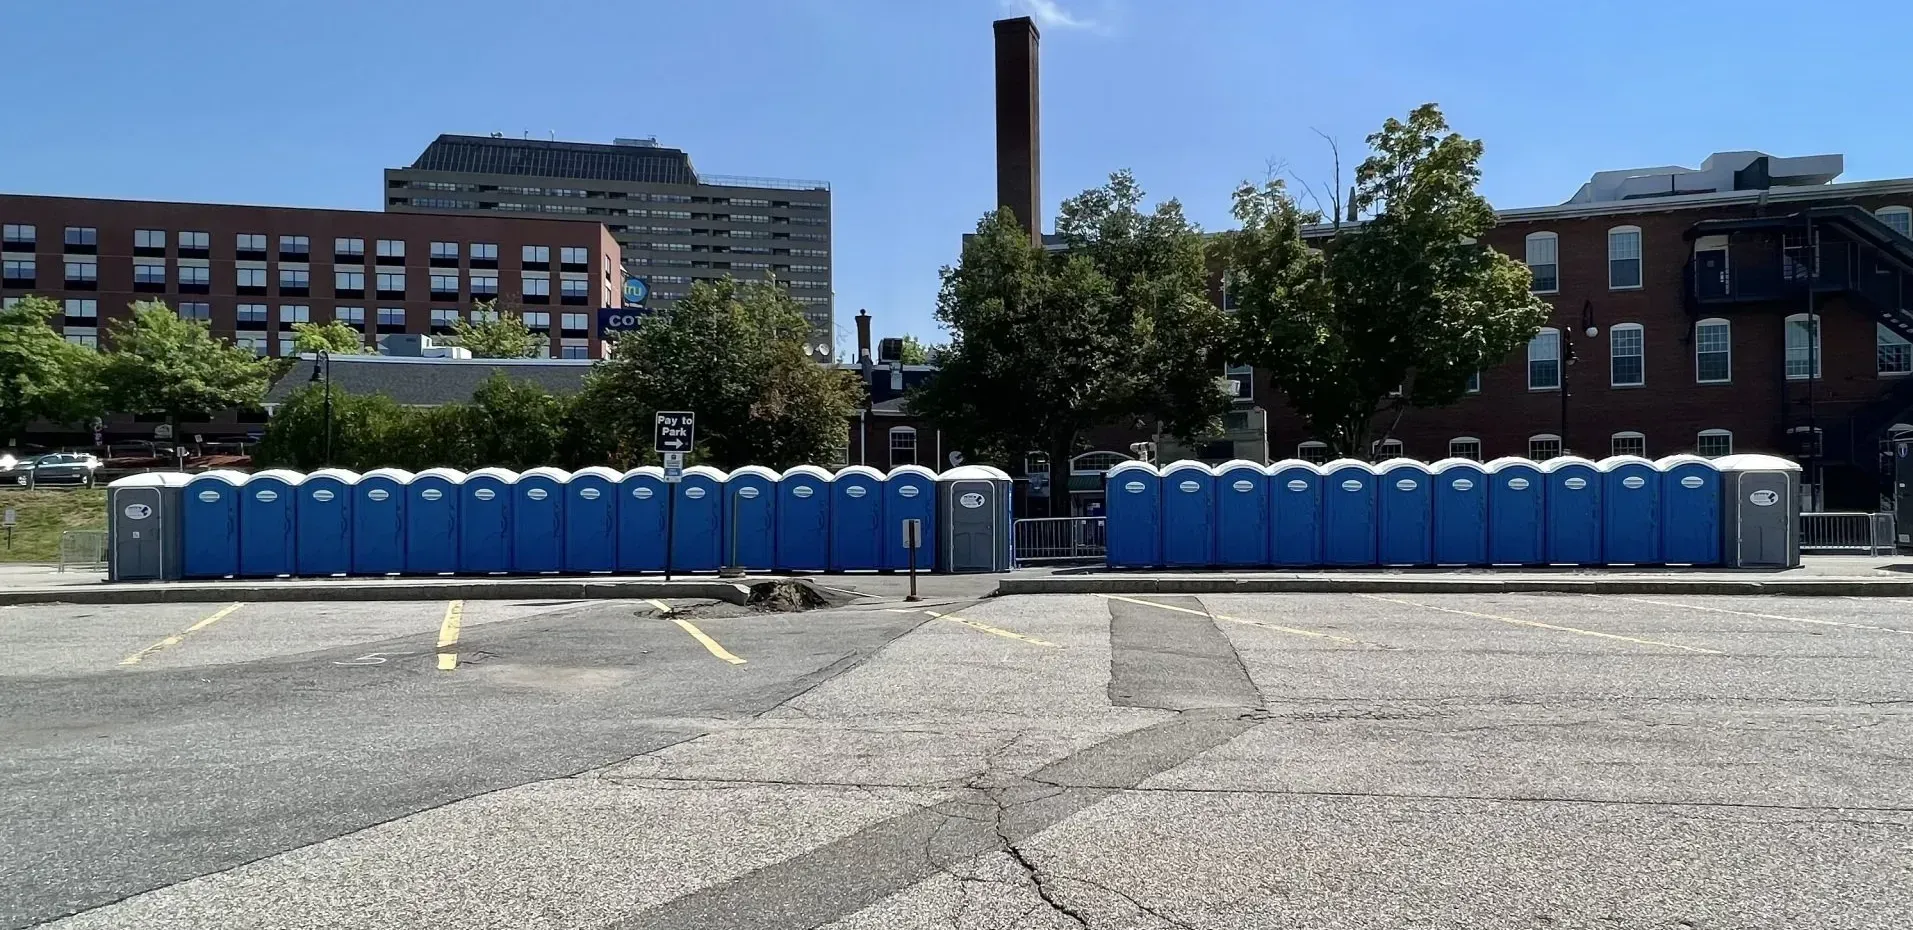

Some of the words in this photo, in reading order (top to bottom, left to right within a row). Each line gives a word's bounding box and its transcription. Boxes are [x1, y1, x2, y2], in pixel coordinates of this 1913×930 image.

[624, 282, 642, 297] tru
[658, 415, 678, 426] Pay
[682, 416, 693, 425] to
[662, 426, 687, 436] Park
